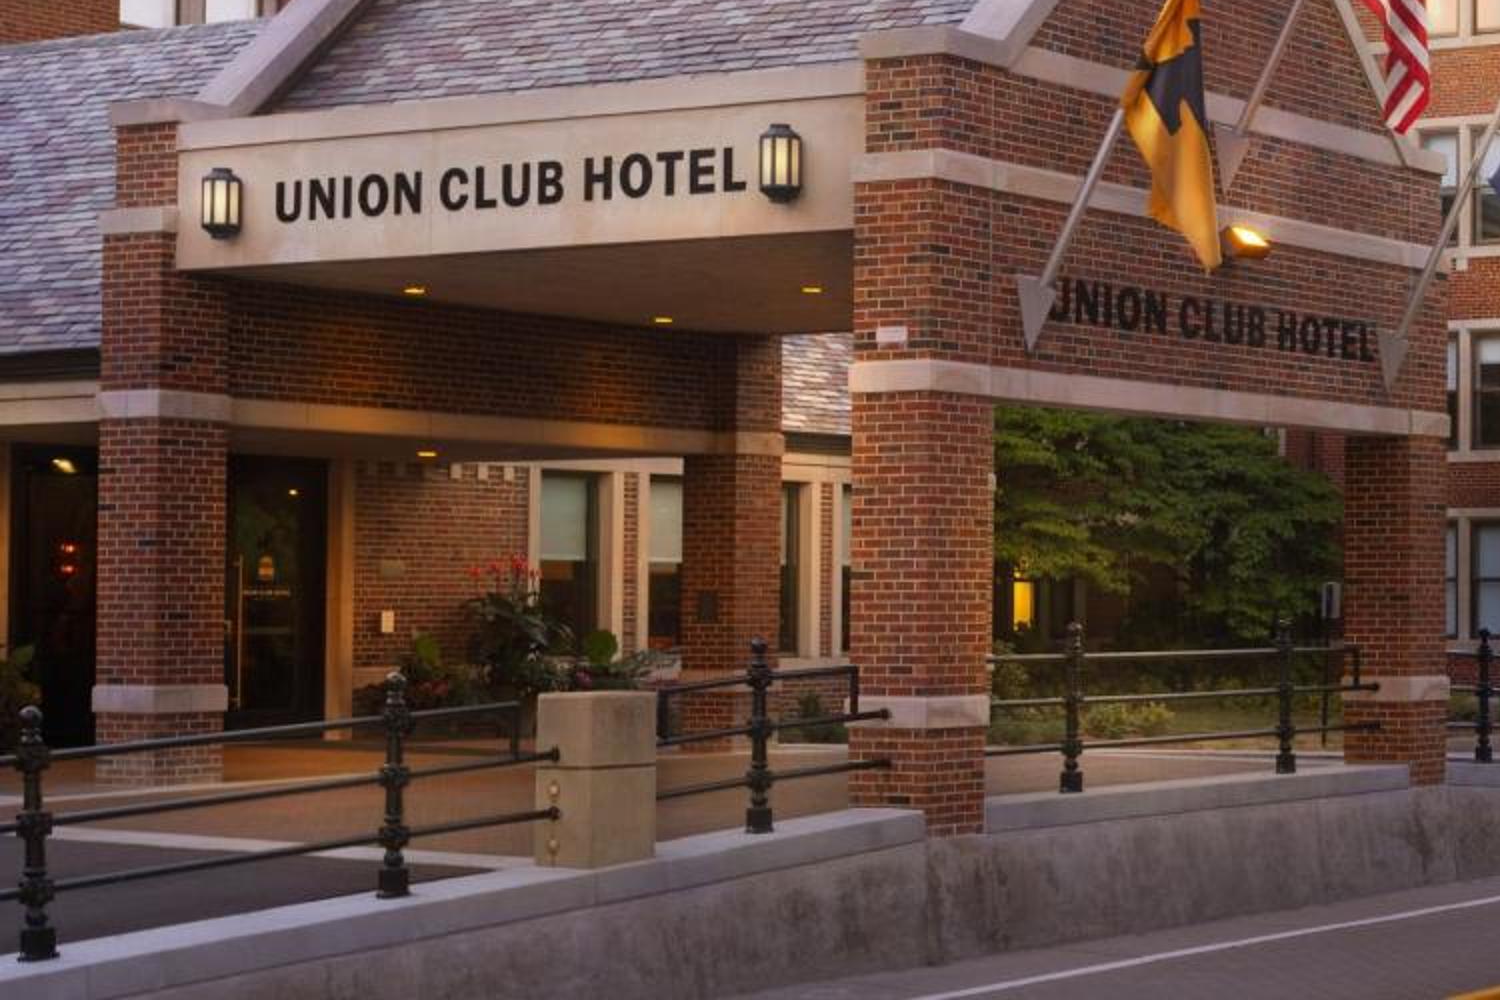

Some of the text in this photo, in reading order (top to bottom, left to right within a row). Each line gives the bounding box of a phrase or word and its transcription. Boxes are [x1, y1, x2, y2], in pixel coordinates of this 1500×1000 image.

[275, 147, 748, 223] UNION CLUB HOTEL
[1179, 296, 1265, 345] CLUB
[1279, 310, 1377, 362] HOTEL
